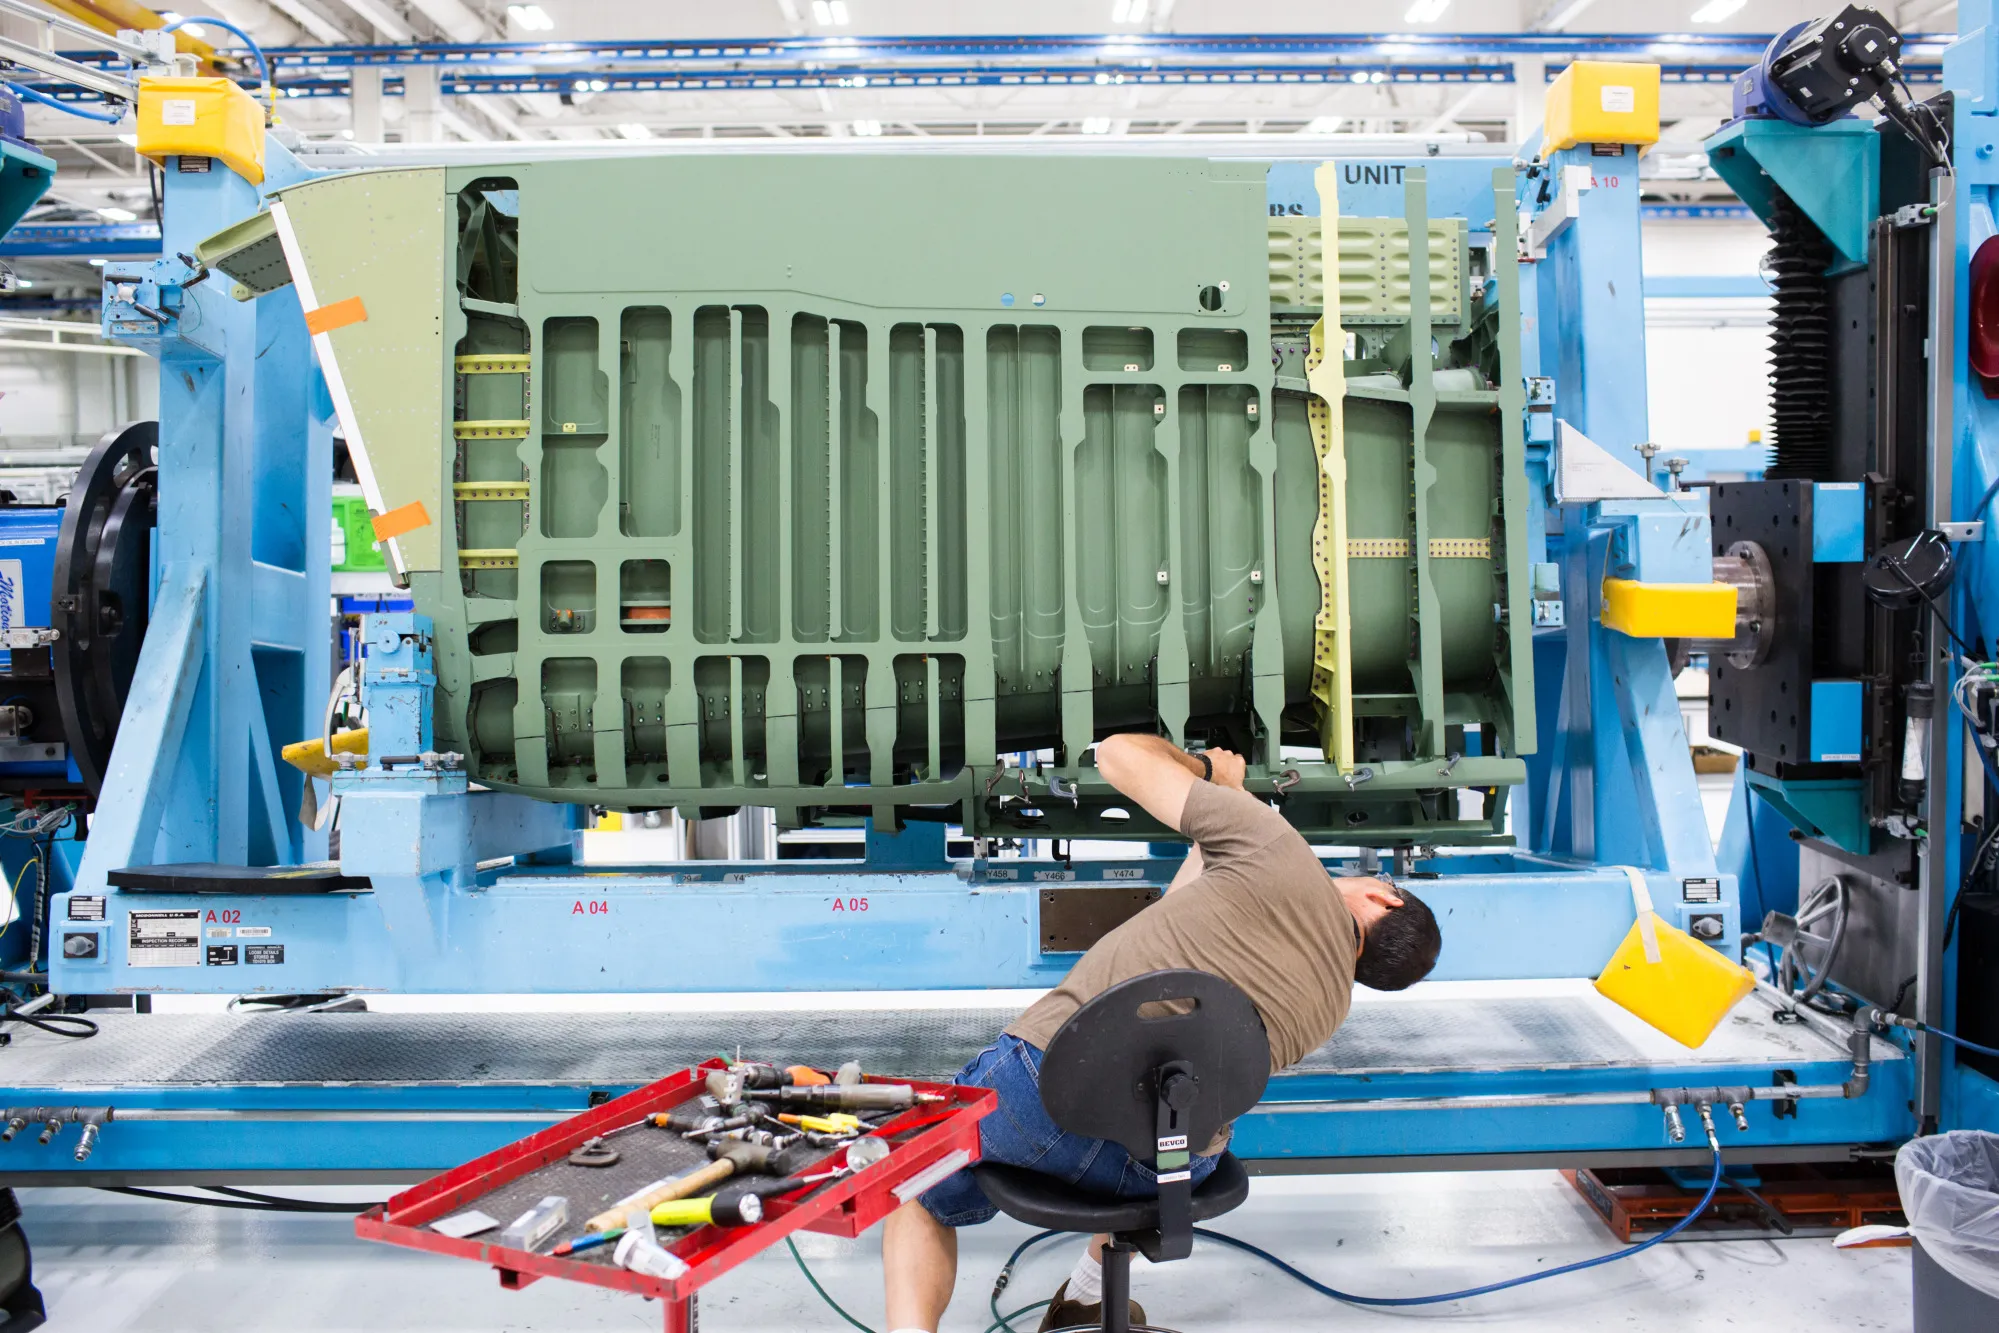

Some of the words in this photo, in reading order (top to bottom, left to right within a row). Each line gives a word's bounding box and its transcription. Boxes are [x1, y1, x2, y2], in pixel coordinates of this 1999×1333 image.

[1345, 165, 1406, 185] UNIT
[1603, 176, 1619, 188] 10
[987, 870, 1008, 878] Y458
[1044, 872, 1065, 880] Y466
[1113, 870, 1134, 878] Y474
[572, 901, 584, 914] A
[589, 900, 608, 915] 04
[832, 898, 845, 911] A
[849, 898, 869, 911] 05
[205, 909, 217, 923] A
[222, 909, 240, 924] 02
[1159, 1139, 1185, 1147] BEVCO
